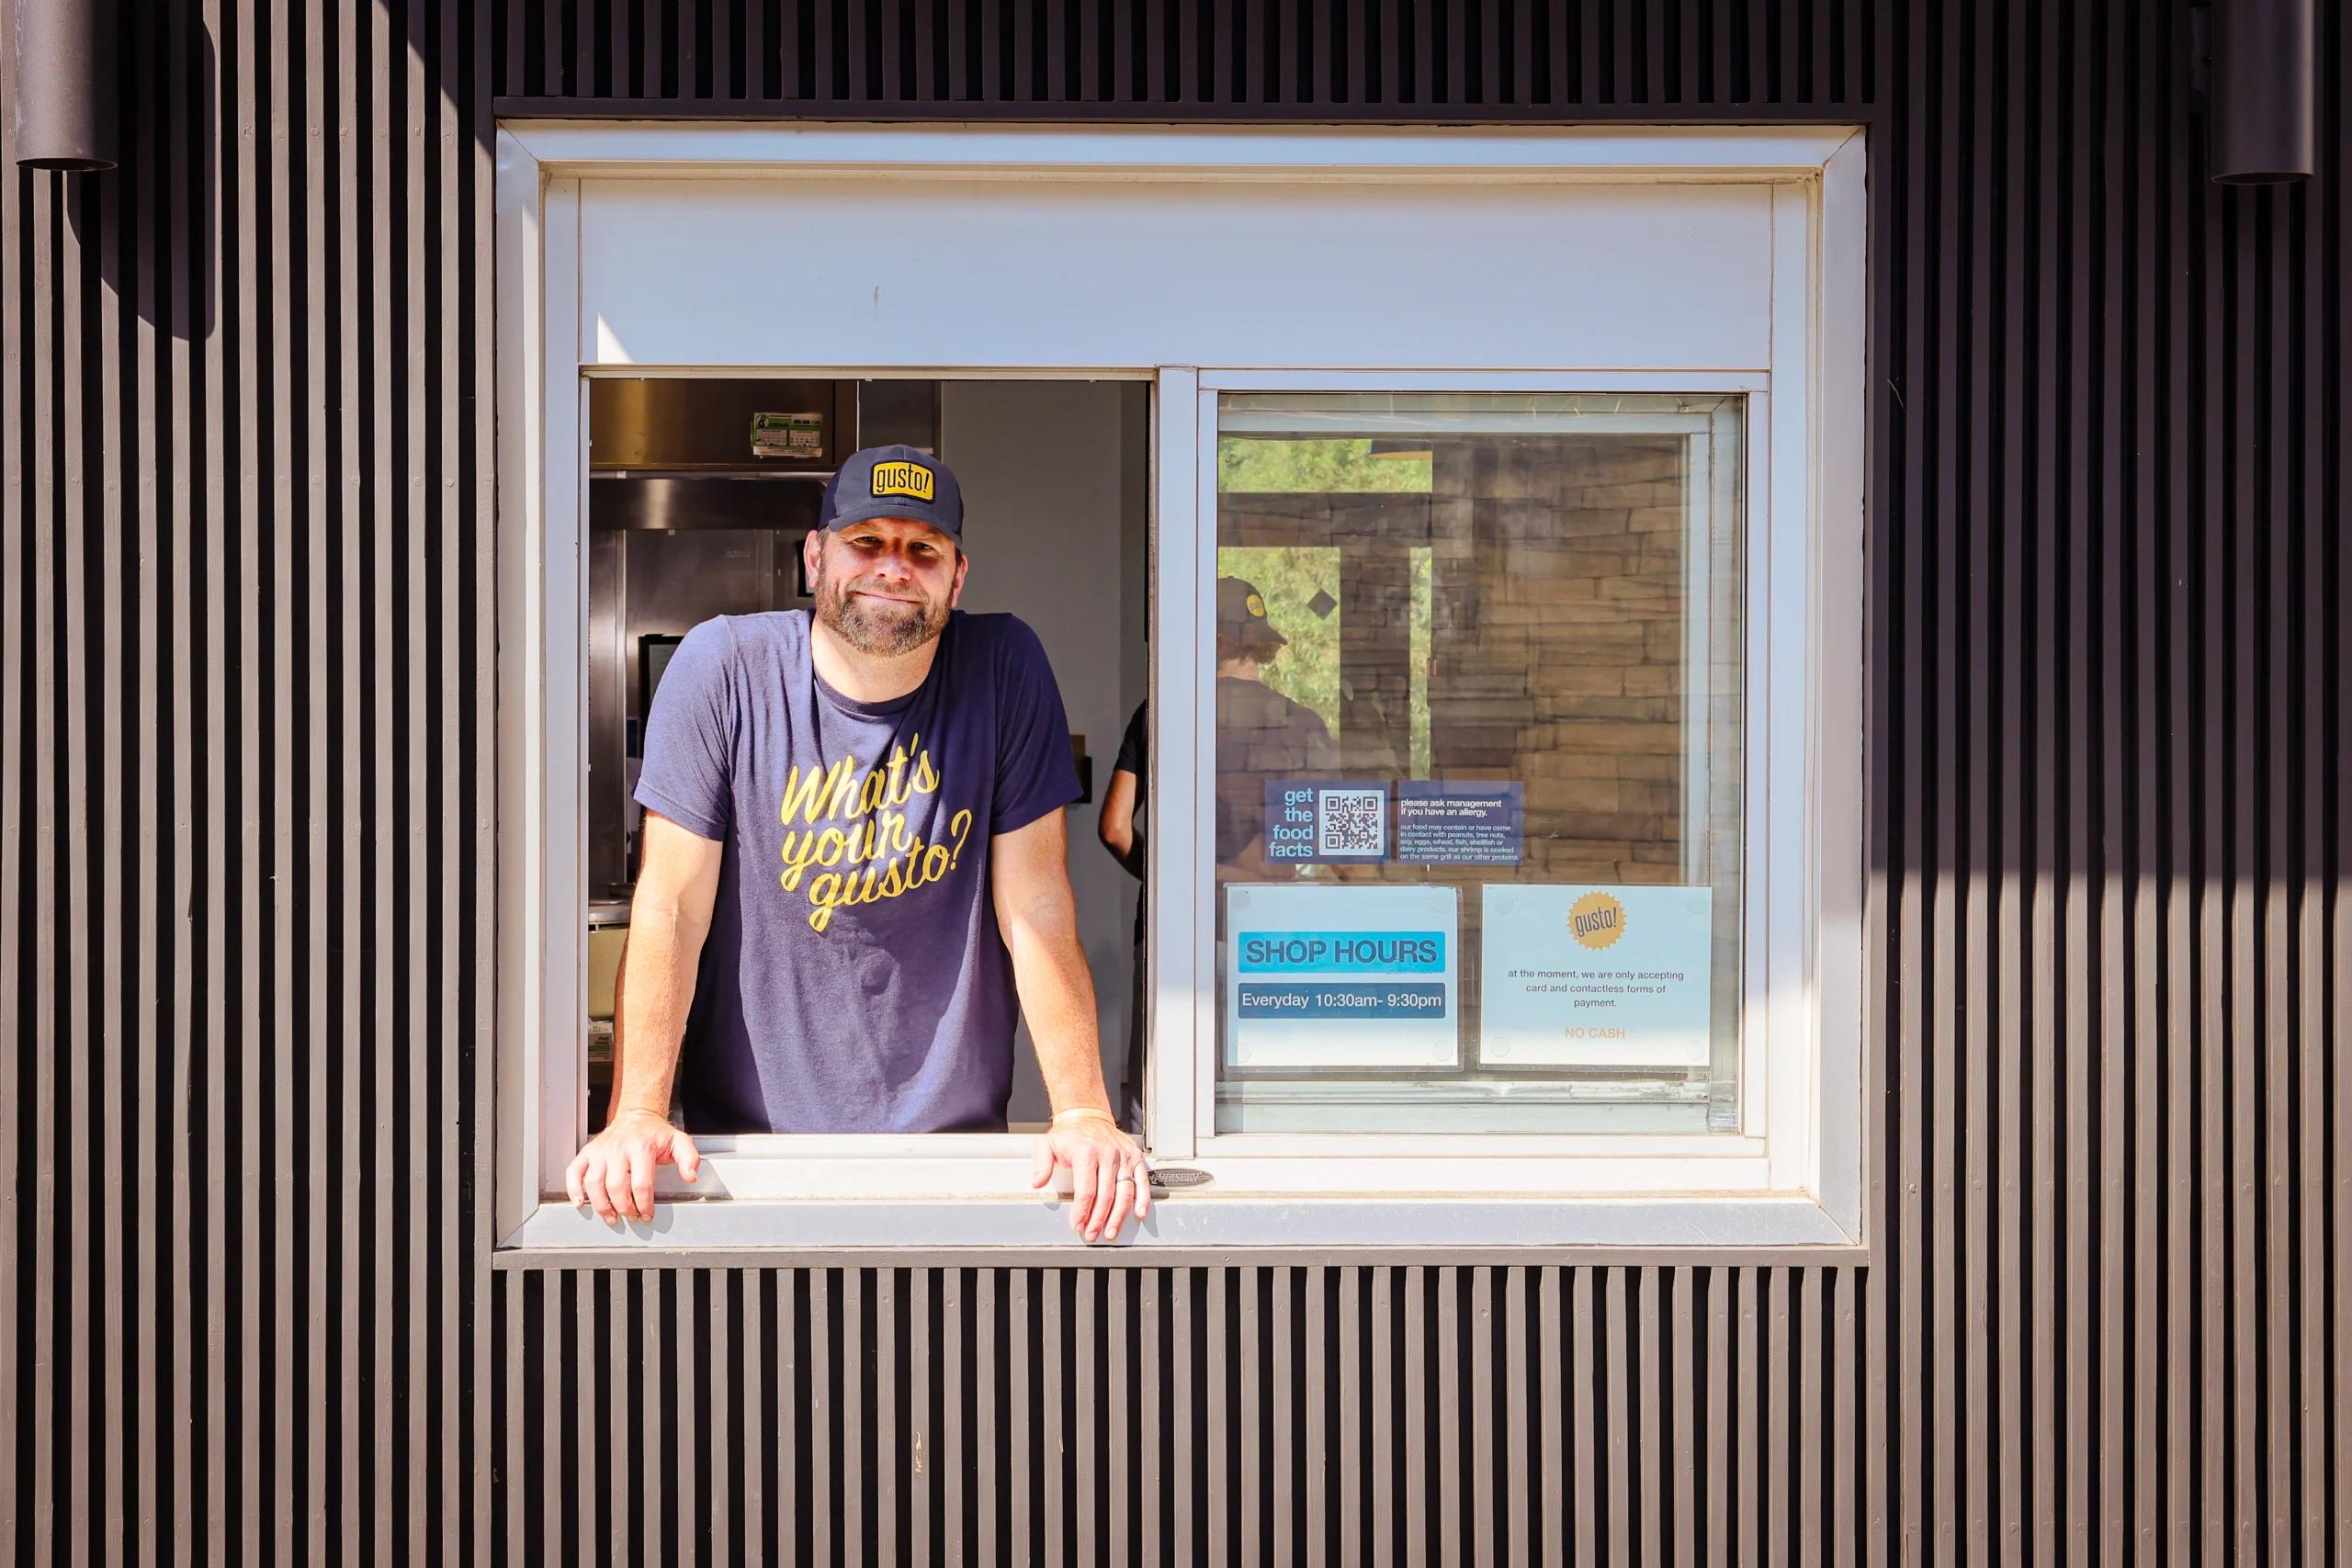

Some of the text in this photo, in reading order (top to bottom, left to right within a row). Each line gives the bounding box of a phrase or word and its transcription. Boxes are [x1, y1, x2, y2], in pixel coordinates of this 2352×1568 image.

[876, 463, 930, 493] gusto!
[781, 733, 940, 826] What's
[1284, 788, 1313, 806] get
[1401, 799, 1428, 807] please
[1446, 800, 1501, 808] management
[1284, 807, 1313, 822] the
[1401, 807, 1408, 816] if
[1459, 808, 1487, 818] allergy.
[1272, 825, 1314, 840] food
[781, 810, 914, 892] your
[1269, 842, 1313, 857] facts
[808, 809, 972, 932] gusto?
[1575, 907, 1618, 937] gusto!
[1246, 939, 1438, 964] SHOP HOURS
[1520, 970, 1535, 978] the
[1537, 971, 1578, 979] moment,
[1615, 970, 1635, 980] only
[1637, 970, 1684, 981] accepting
[1526, 984, 1667, 993] card and contactless forms of
[1242, 993, 1442, 1010] Everyday 10:30am- 9:30pm
[1574, 998, 1617, 1008] payment.
[1565, 1028, 1626, 1039] NO CASH
